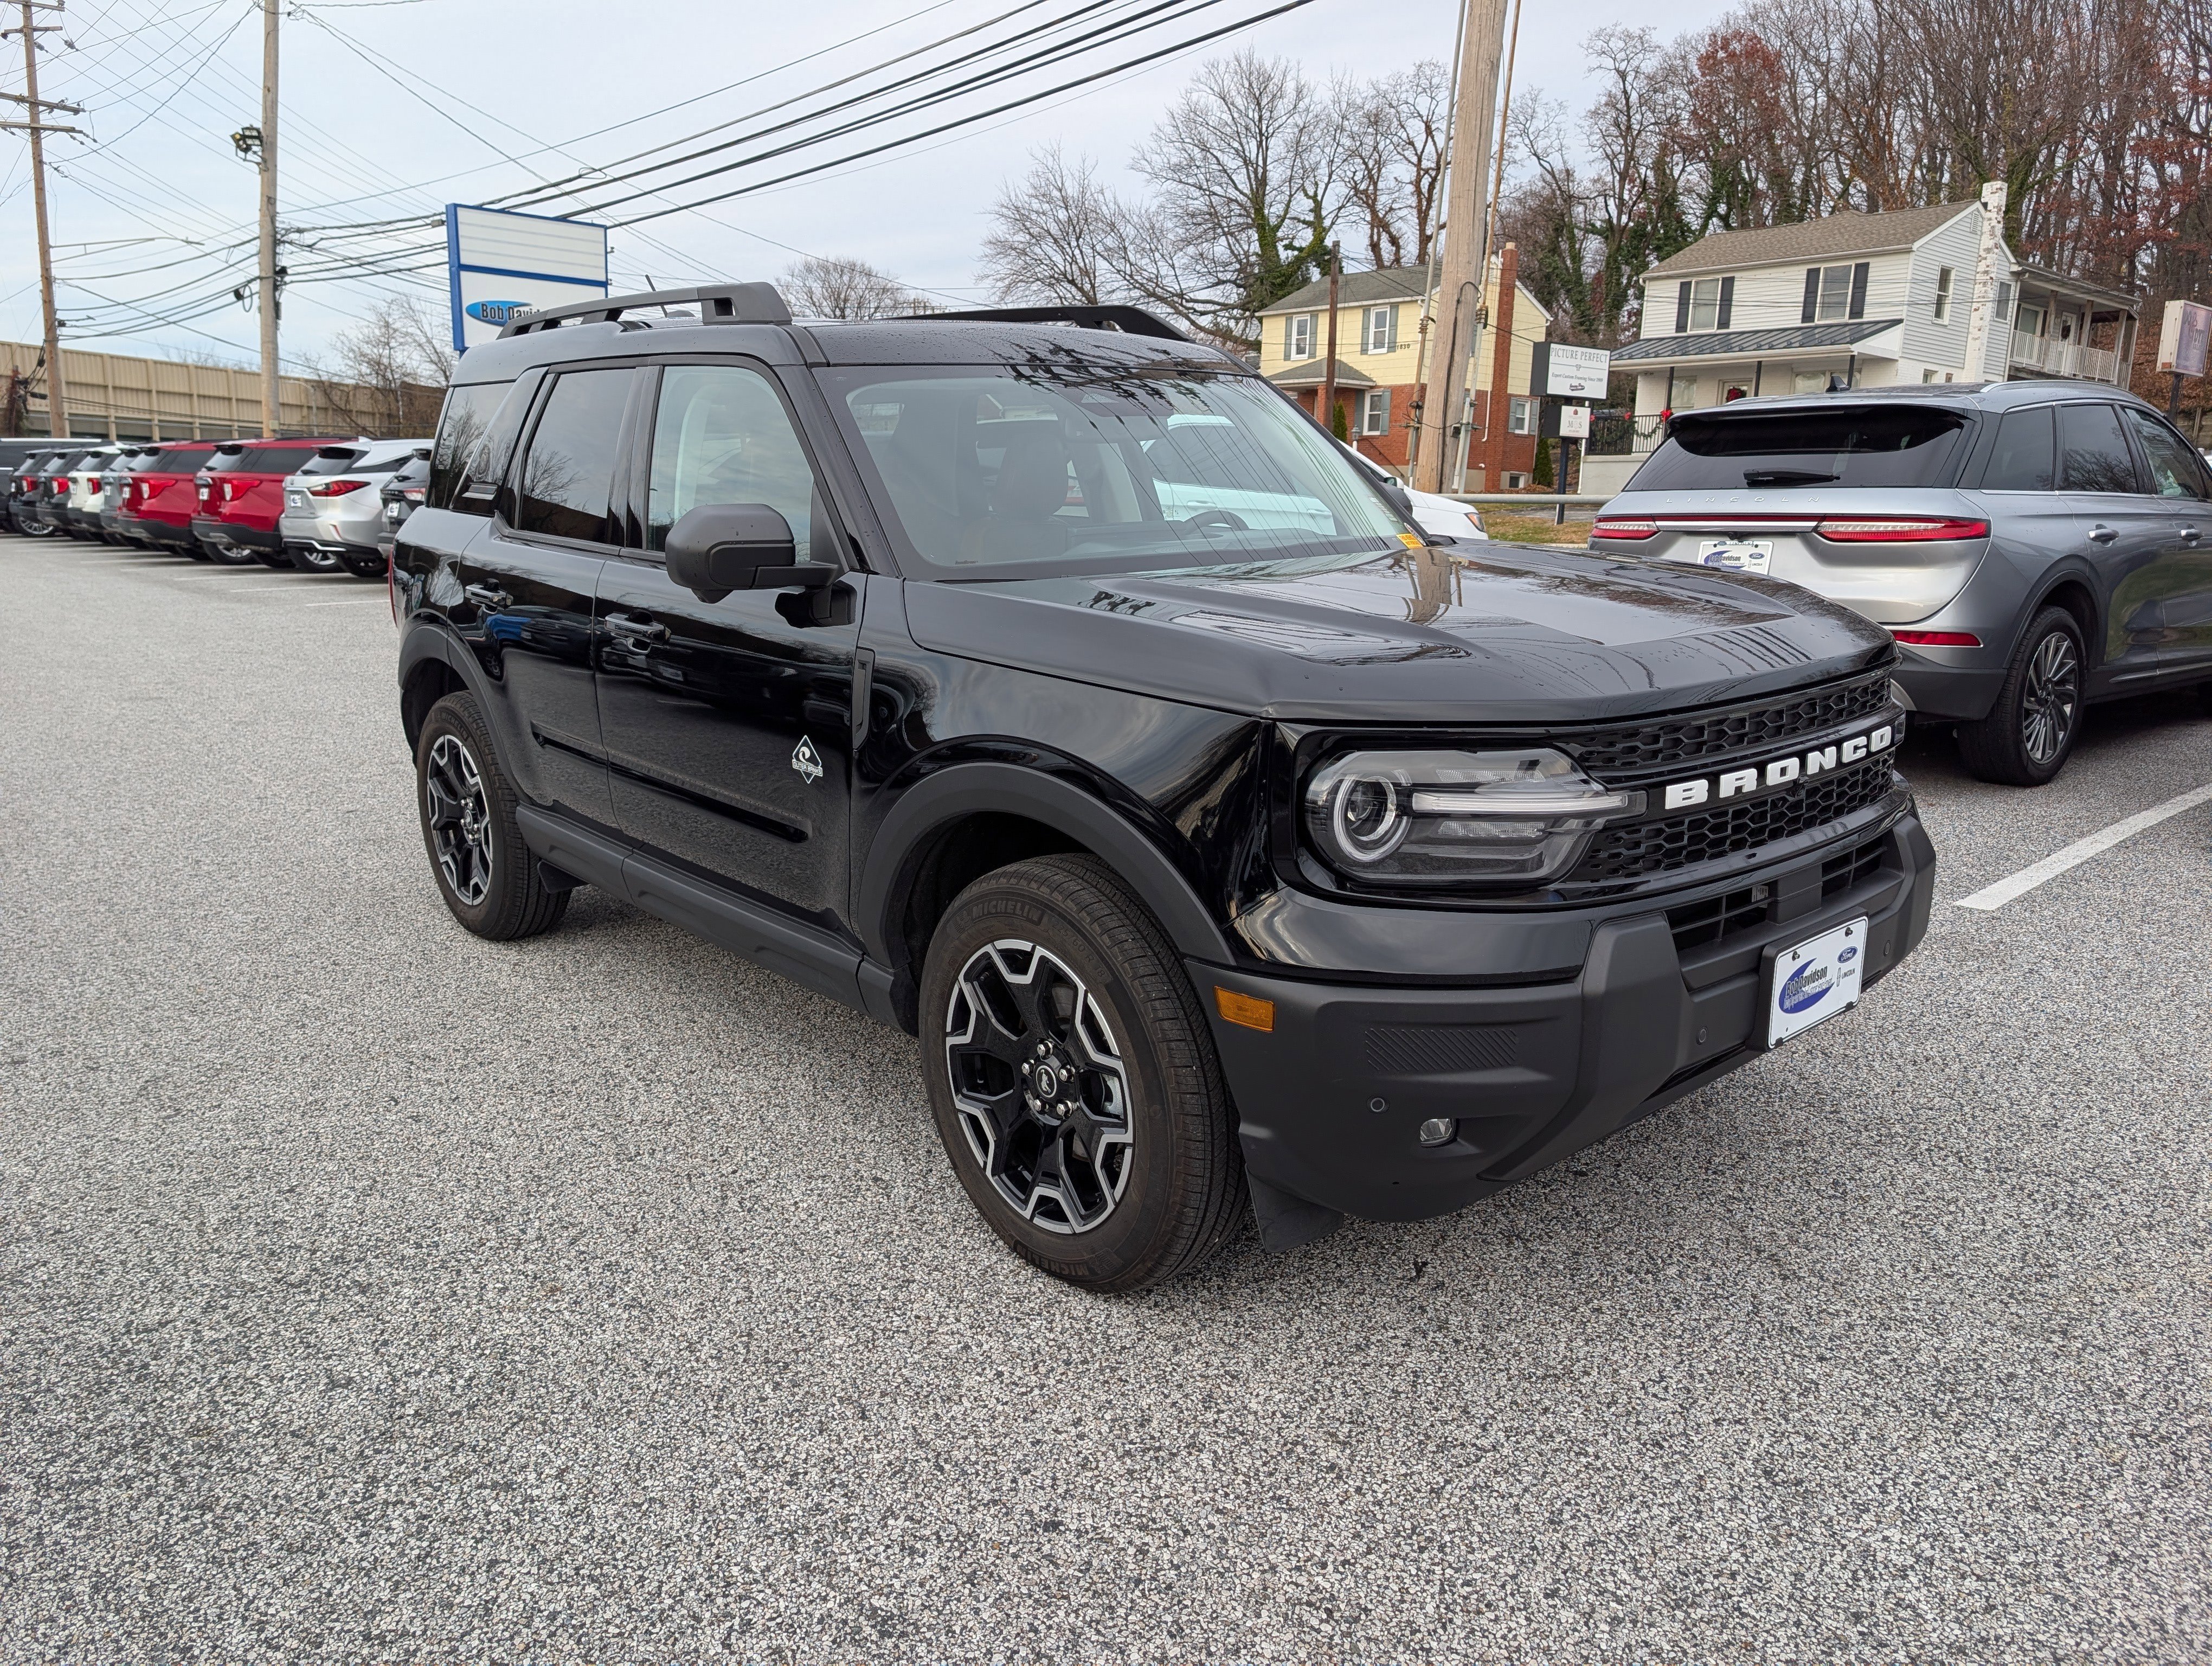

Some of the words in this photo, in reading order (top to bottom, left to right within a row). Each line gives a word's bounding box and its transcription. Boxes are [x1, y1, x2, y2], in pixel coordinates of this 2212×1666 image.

[481, 304, 504, 320] Bob
[1551, 348, 1579, 359] PICTURE
[1580, 351, 1608, 363] PERFECT
[793, 761, 807, 770] OUTER
[807, 766, 821, 774] BANKS
[1665, 726, 1892, 810] BRONCO
[972, 900, 1041, 922] MICHELIN
[1840, 949, 1854, 961] Ford
[1786, 977, 1799, 996] Bob
[1798, 965, 1828, 990] Davidson
[1841, 967, 1855, 979] LINCOLN
